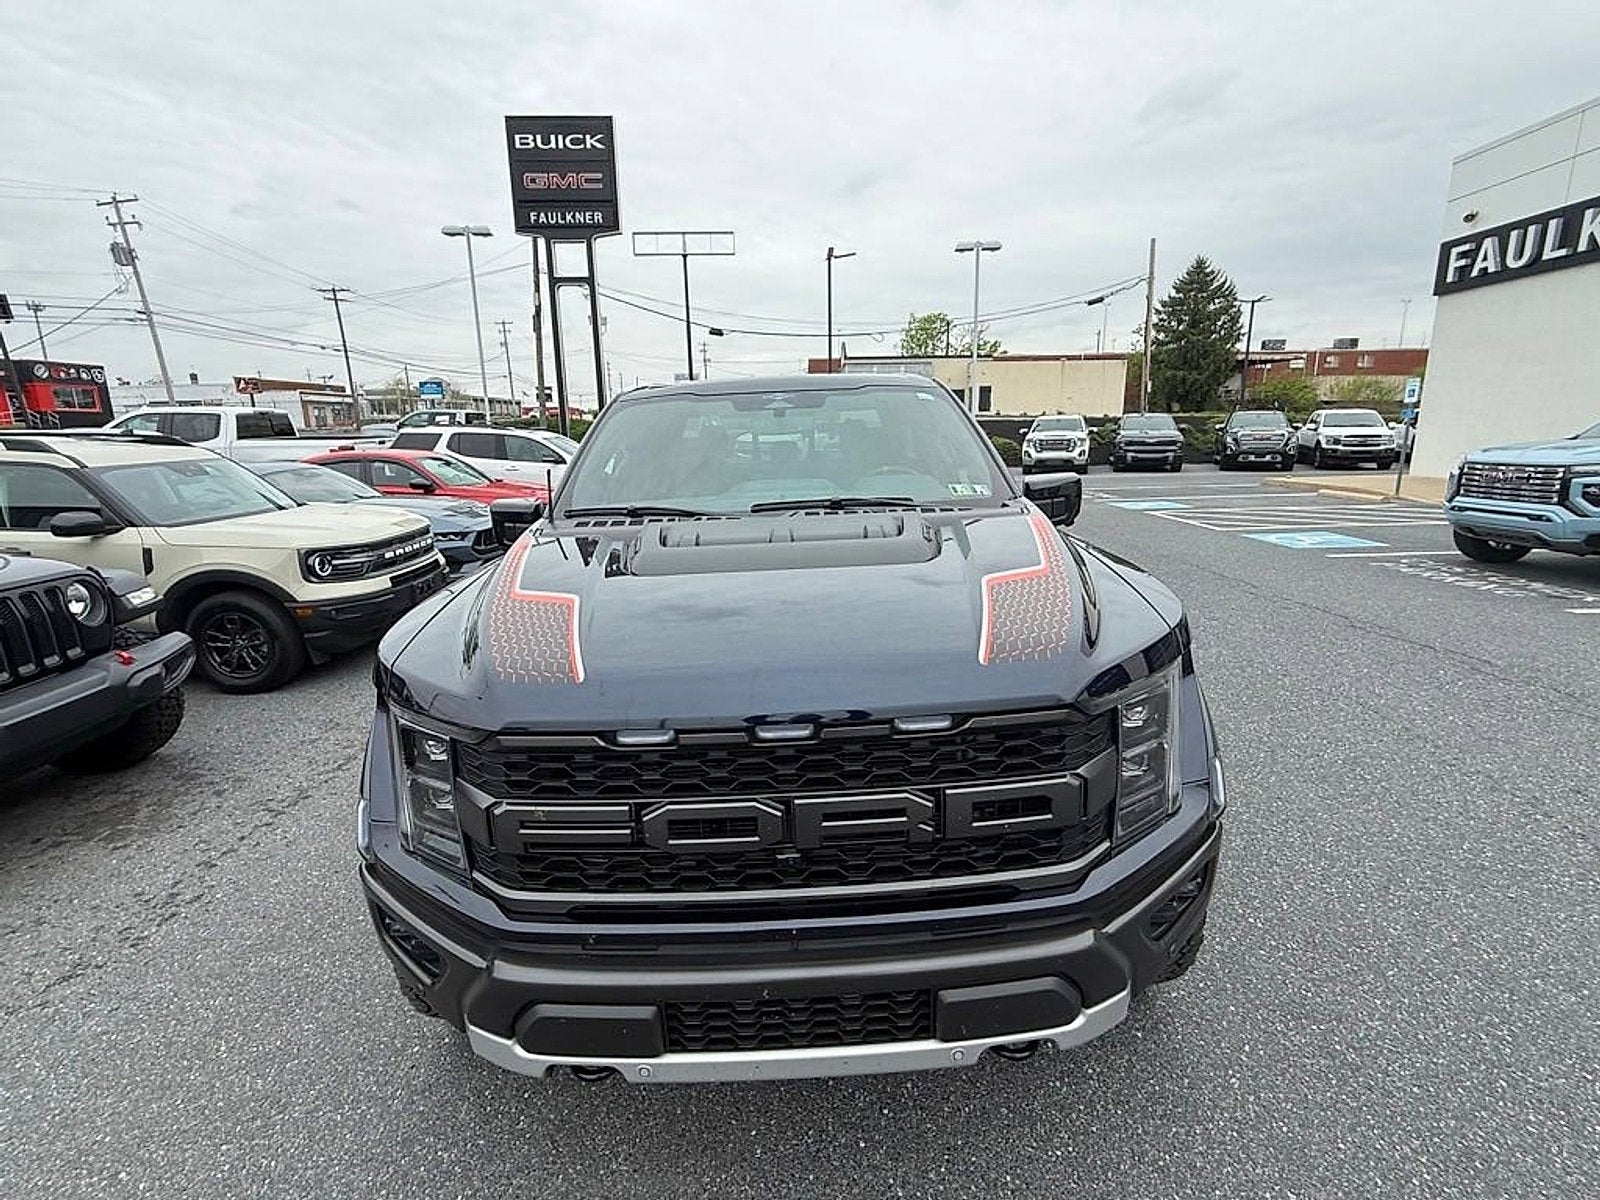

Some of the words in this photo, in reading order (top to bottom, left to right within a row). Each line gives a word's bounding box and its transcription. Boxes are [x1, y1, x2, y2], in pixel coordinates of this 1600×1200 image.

[514, 134, 606, 149] BUICK
[523, 173, 603, 189] GMC
[530, 212, 603, 224] FAULKNER
[1446, 207, 1600, 283] FAULK
[492, 778, 1084, 852] FORD
